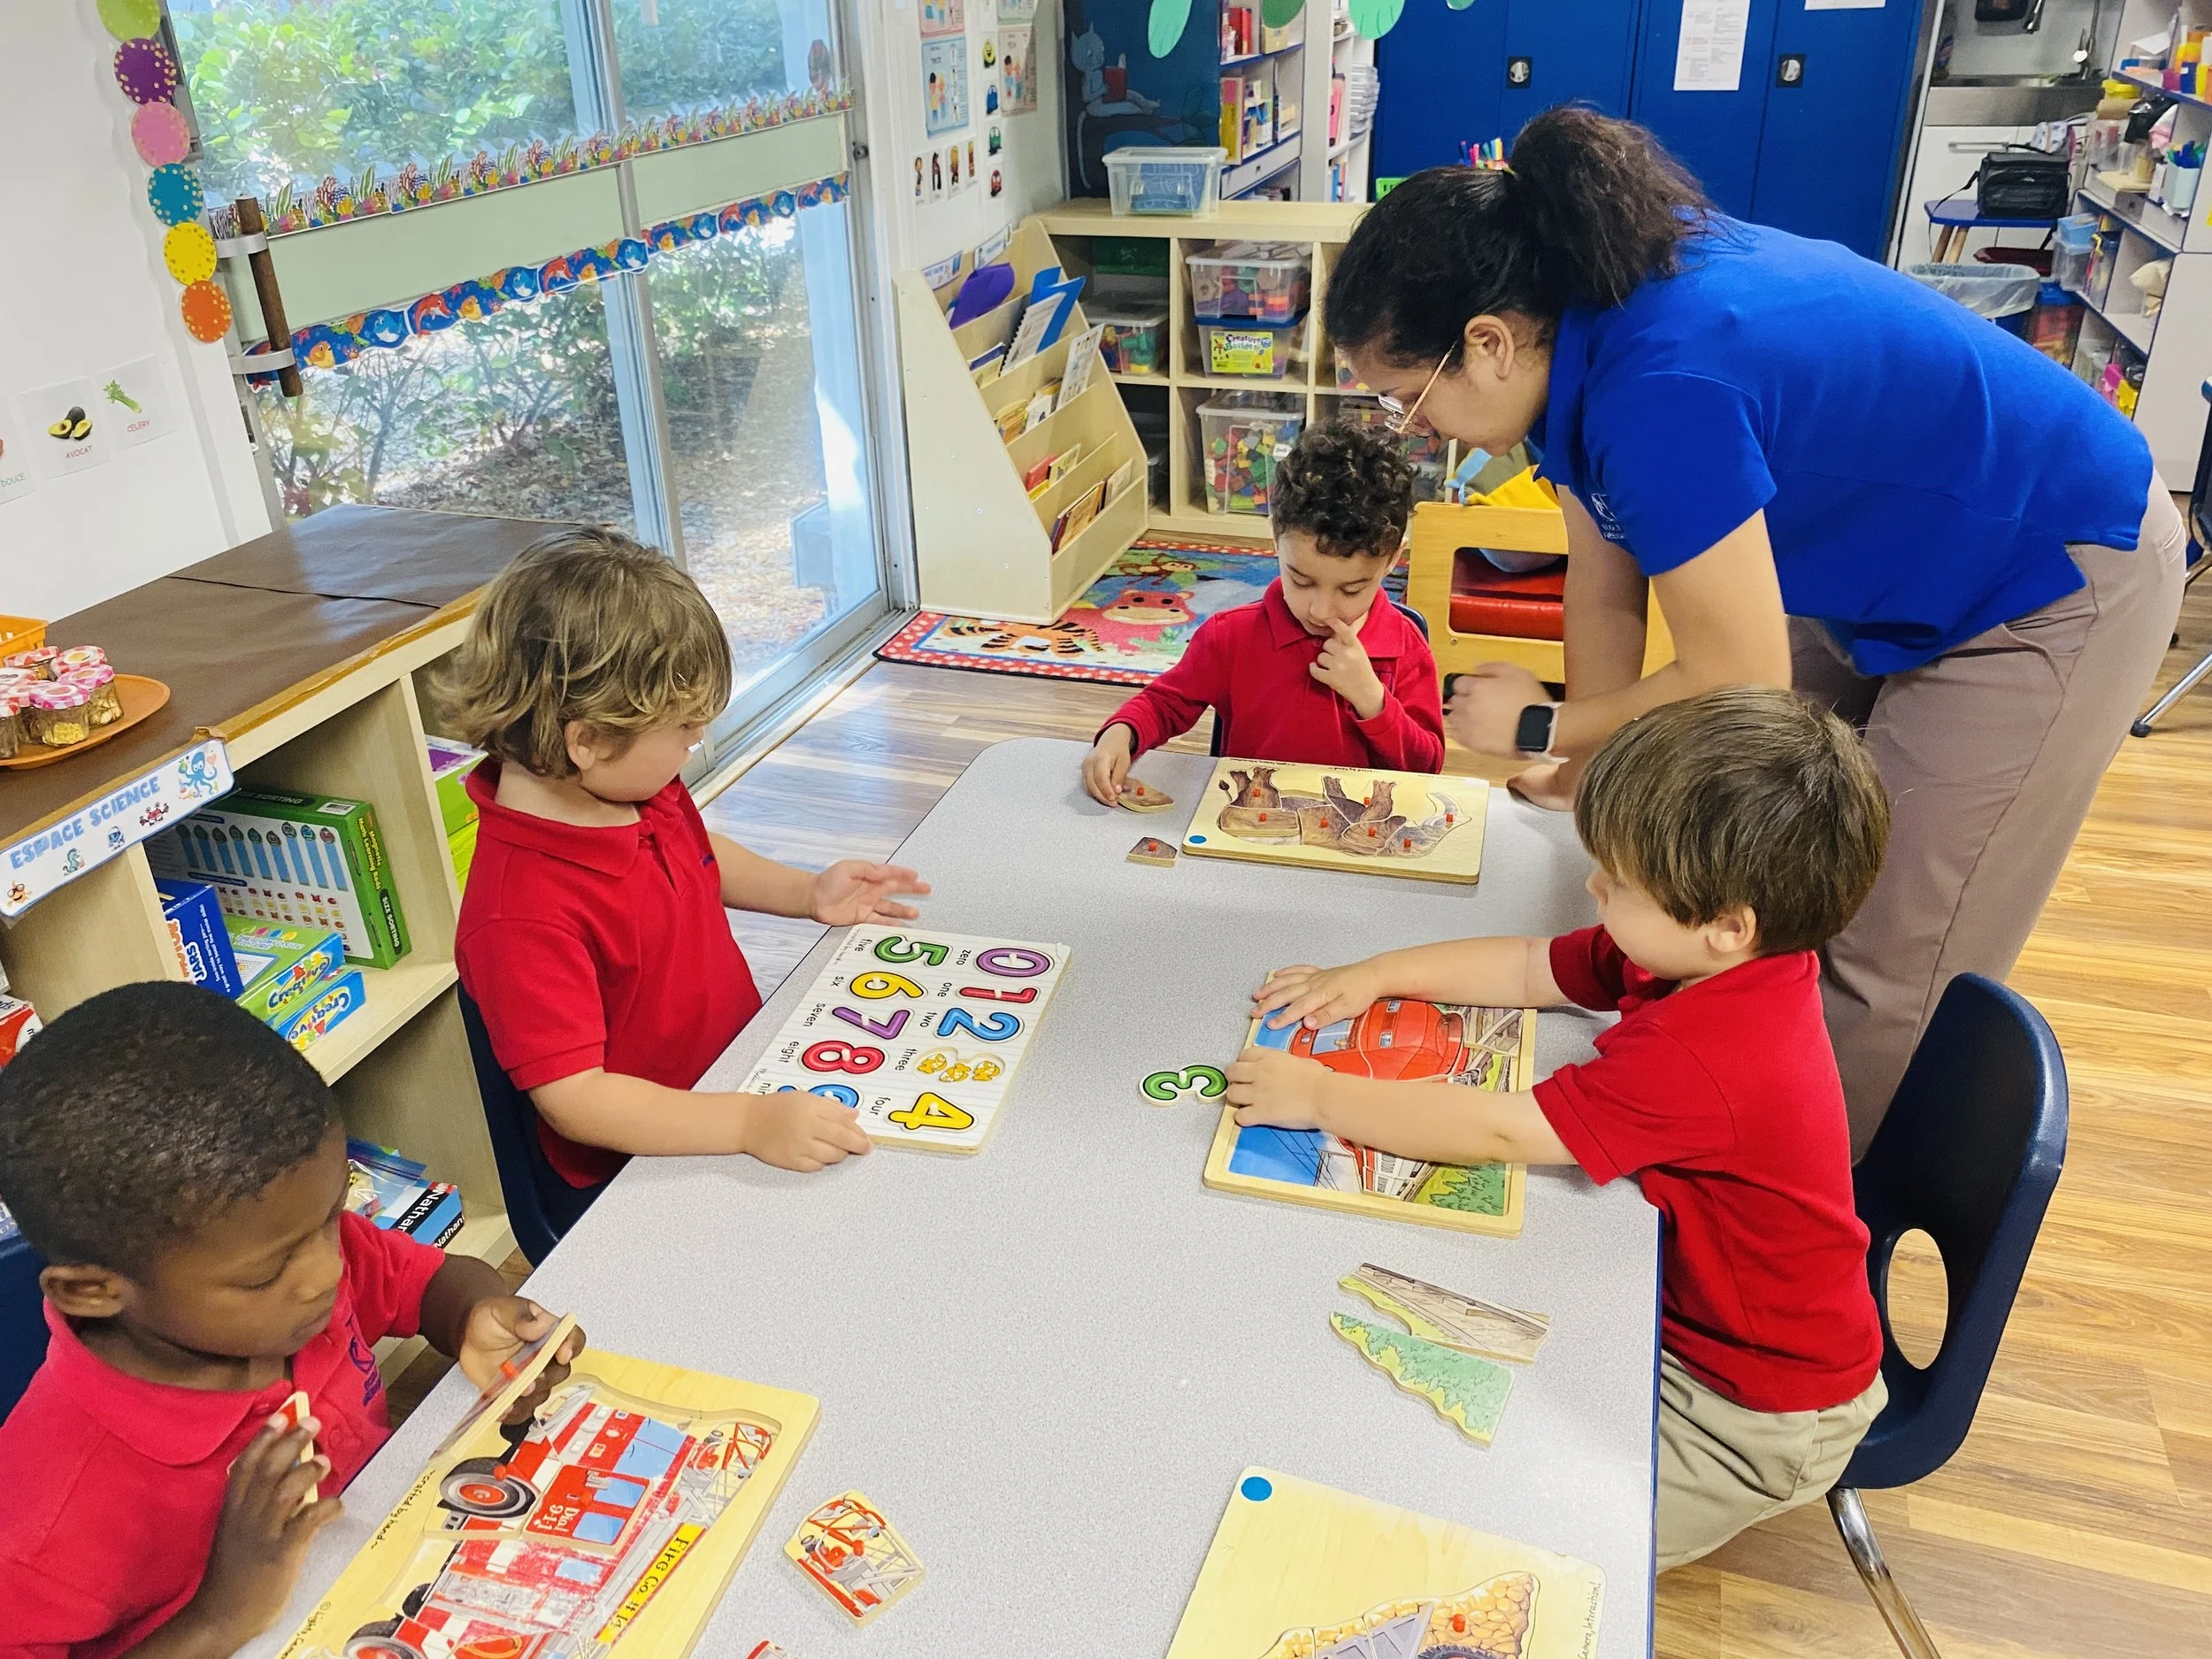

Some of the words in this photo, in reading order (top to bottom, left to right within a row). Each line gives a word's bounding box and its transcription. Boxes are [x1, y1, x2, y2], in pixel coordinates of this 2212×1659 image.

[65, 445, 93, 459] AVOCAT
[1, 472, 26, 488] DOUCE
[10, 818, 85, 870] ESPACE
[89, 776, 161, 827] SCIENCE
[357, 817, 367, 838] Math
[364, 837, 376, 872] Learning
[373, 871, 381, 891] Rods
[368, 830, 382, 868] Magnetic
[382, 896, 391, 914] SIZE
[387, 913, 400, 948] SORTING
[854, 938, 872, 953] five
[874, 935, 949, 966] 5
[956, 949, 972, 965] zero
[186, 944, 205, 982] JARS
[976, 947, 1050, 978] 0
[830, 975, 845, 987] six
[849, 971, 925, 1000] 6
[937, 981, 953, 997] one
[959, 987, 1038, 1003] 1
[802, 1002, 826, 1028] seven
[832, 1006, 910, 1041] 7
[919, 1011, 938, 1028] two
[937, 1007, 1021, 1041] 2
[779, 1041, 800, 1064] eight
[801, 1040, 886, 1075] 8
[895, 1048, 918, 1072] three
[1142, 1064, 1228, 1101] 3
[869, 1095, 891, 1117] four
[887, 1092, 974, 1131] 4
[434, 1217, 463, 1248] Nathan
[533, 1503, 564, 1532] 9-1-1
[554, 1506, 580, 1532] Dial
[656, 1536, 689, 1572] Fire
[636, 1575, 659, 1595] Co.
[1582, 1581, 1602, 1629] Interaction!
[1578, 1630, 1596, 1659] Camera,
